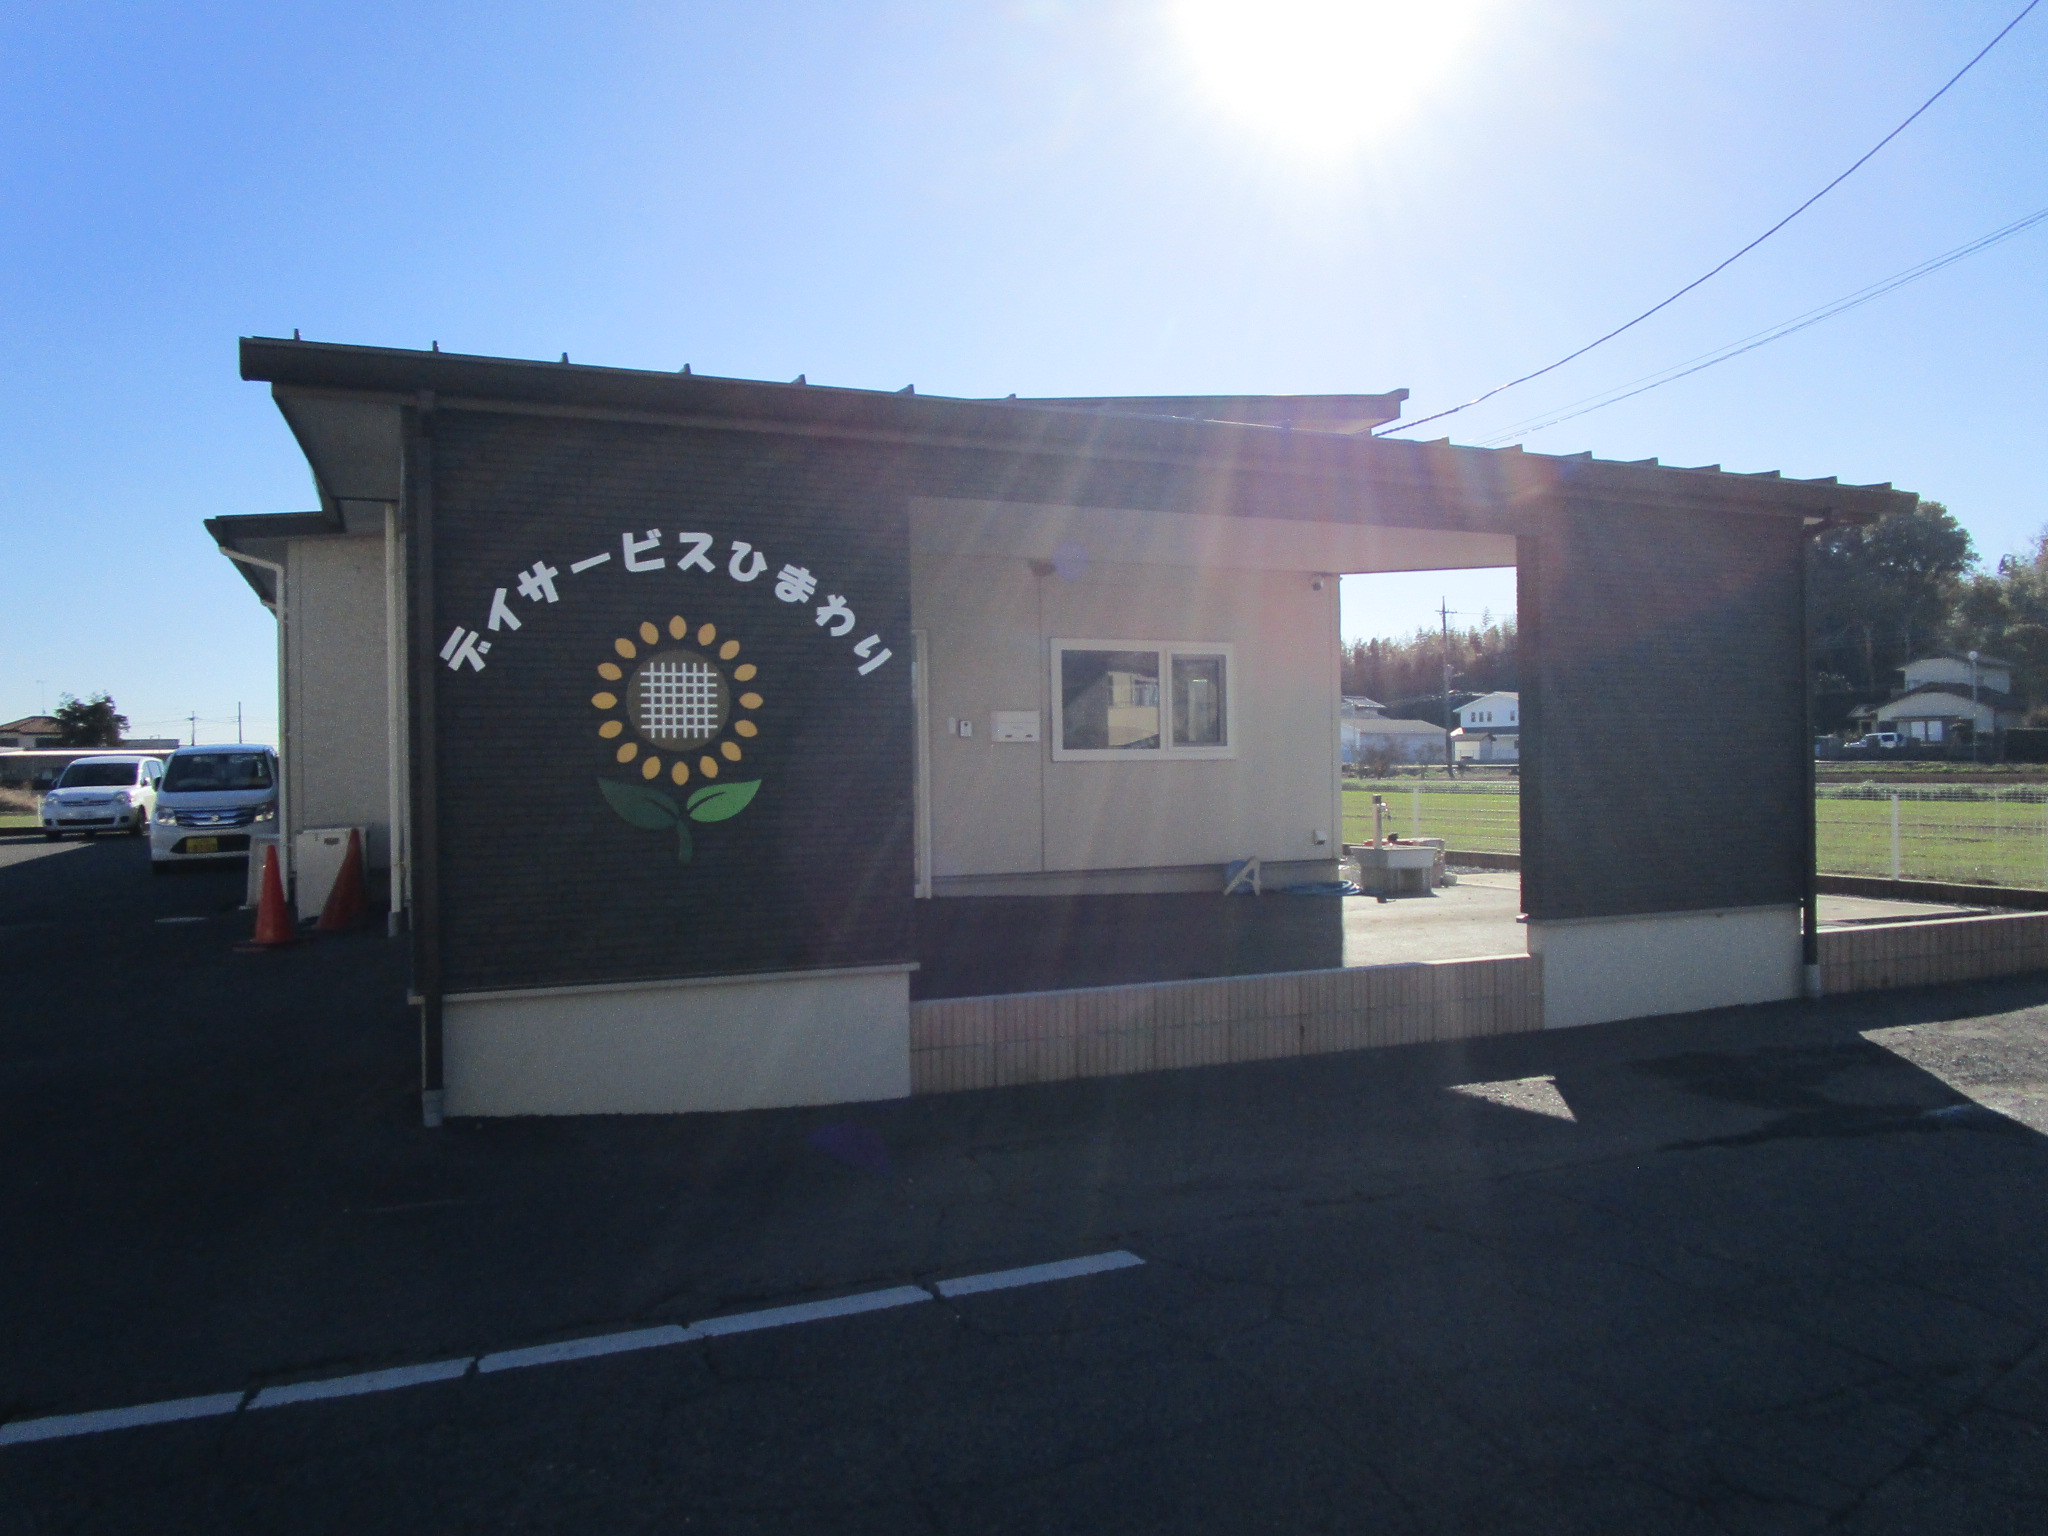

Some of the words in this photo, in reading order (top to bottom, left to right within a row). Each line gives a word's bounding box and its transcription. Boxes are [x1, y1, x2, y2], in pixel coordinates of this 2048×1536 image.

[439, 528, 893, 676] デイサービスひまわり
